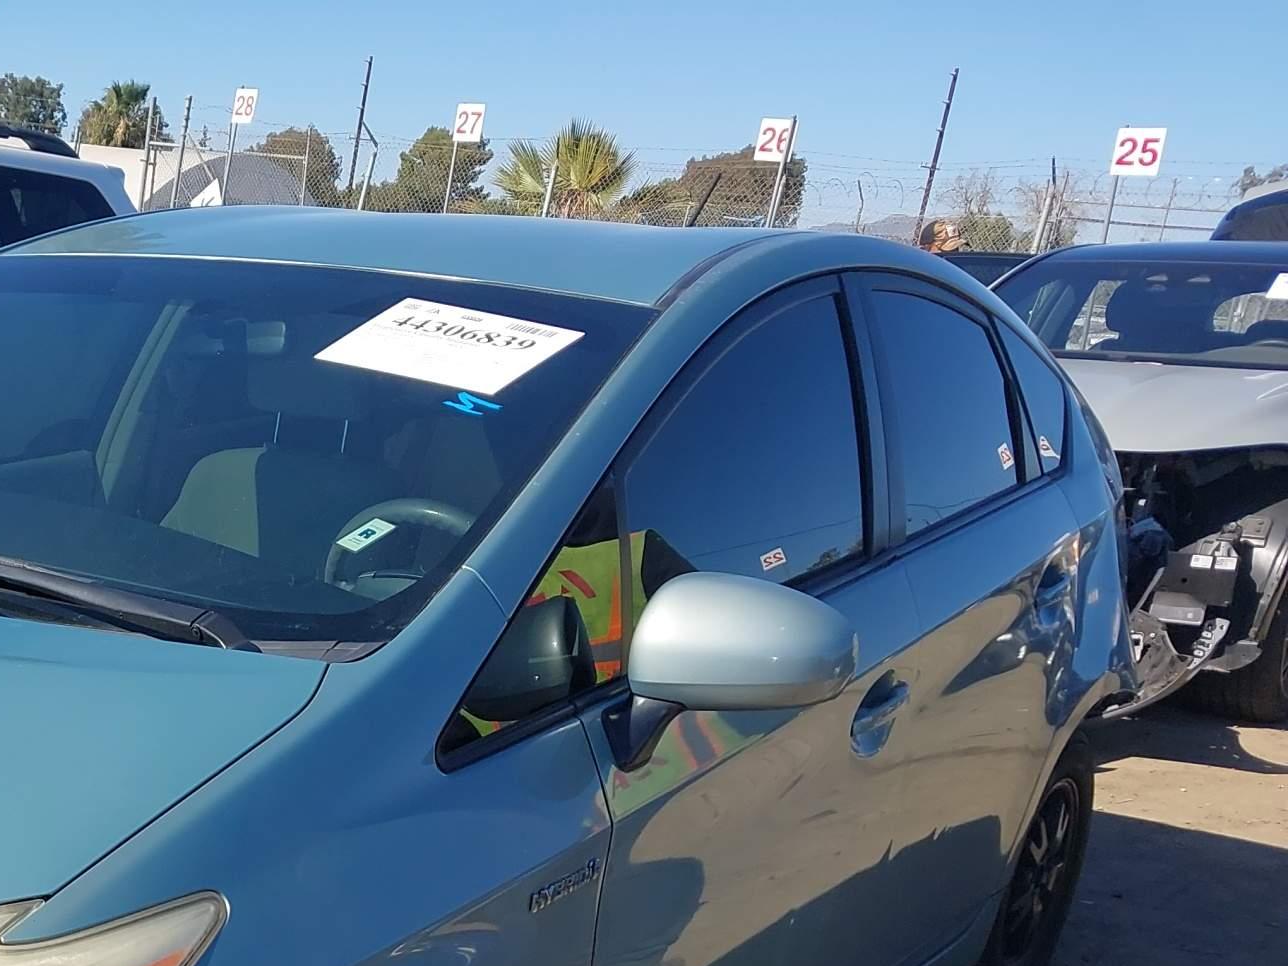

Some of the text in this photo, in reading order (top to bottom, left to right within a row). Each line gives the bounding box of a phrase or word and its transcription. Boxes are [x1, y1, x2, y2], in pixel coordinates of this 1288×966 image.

[235, 95, 255, 116] 28
[456, 110, 483, 135] 27
[758, 127, 789, 154] 26
[1115, 137, 1161, 167] 25
[392, 315, 537, 350] 44306839
